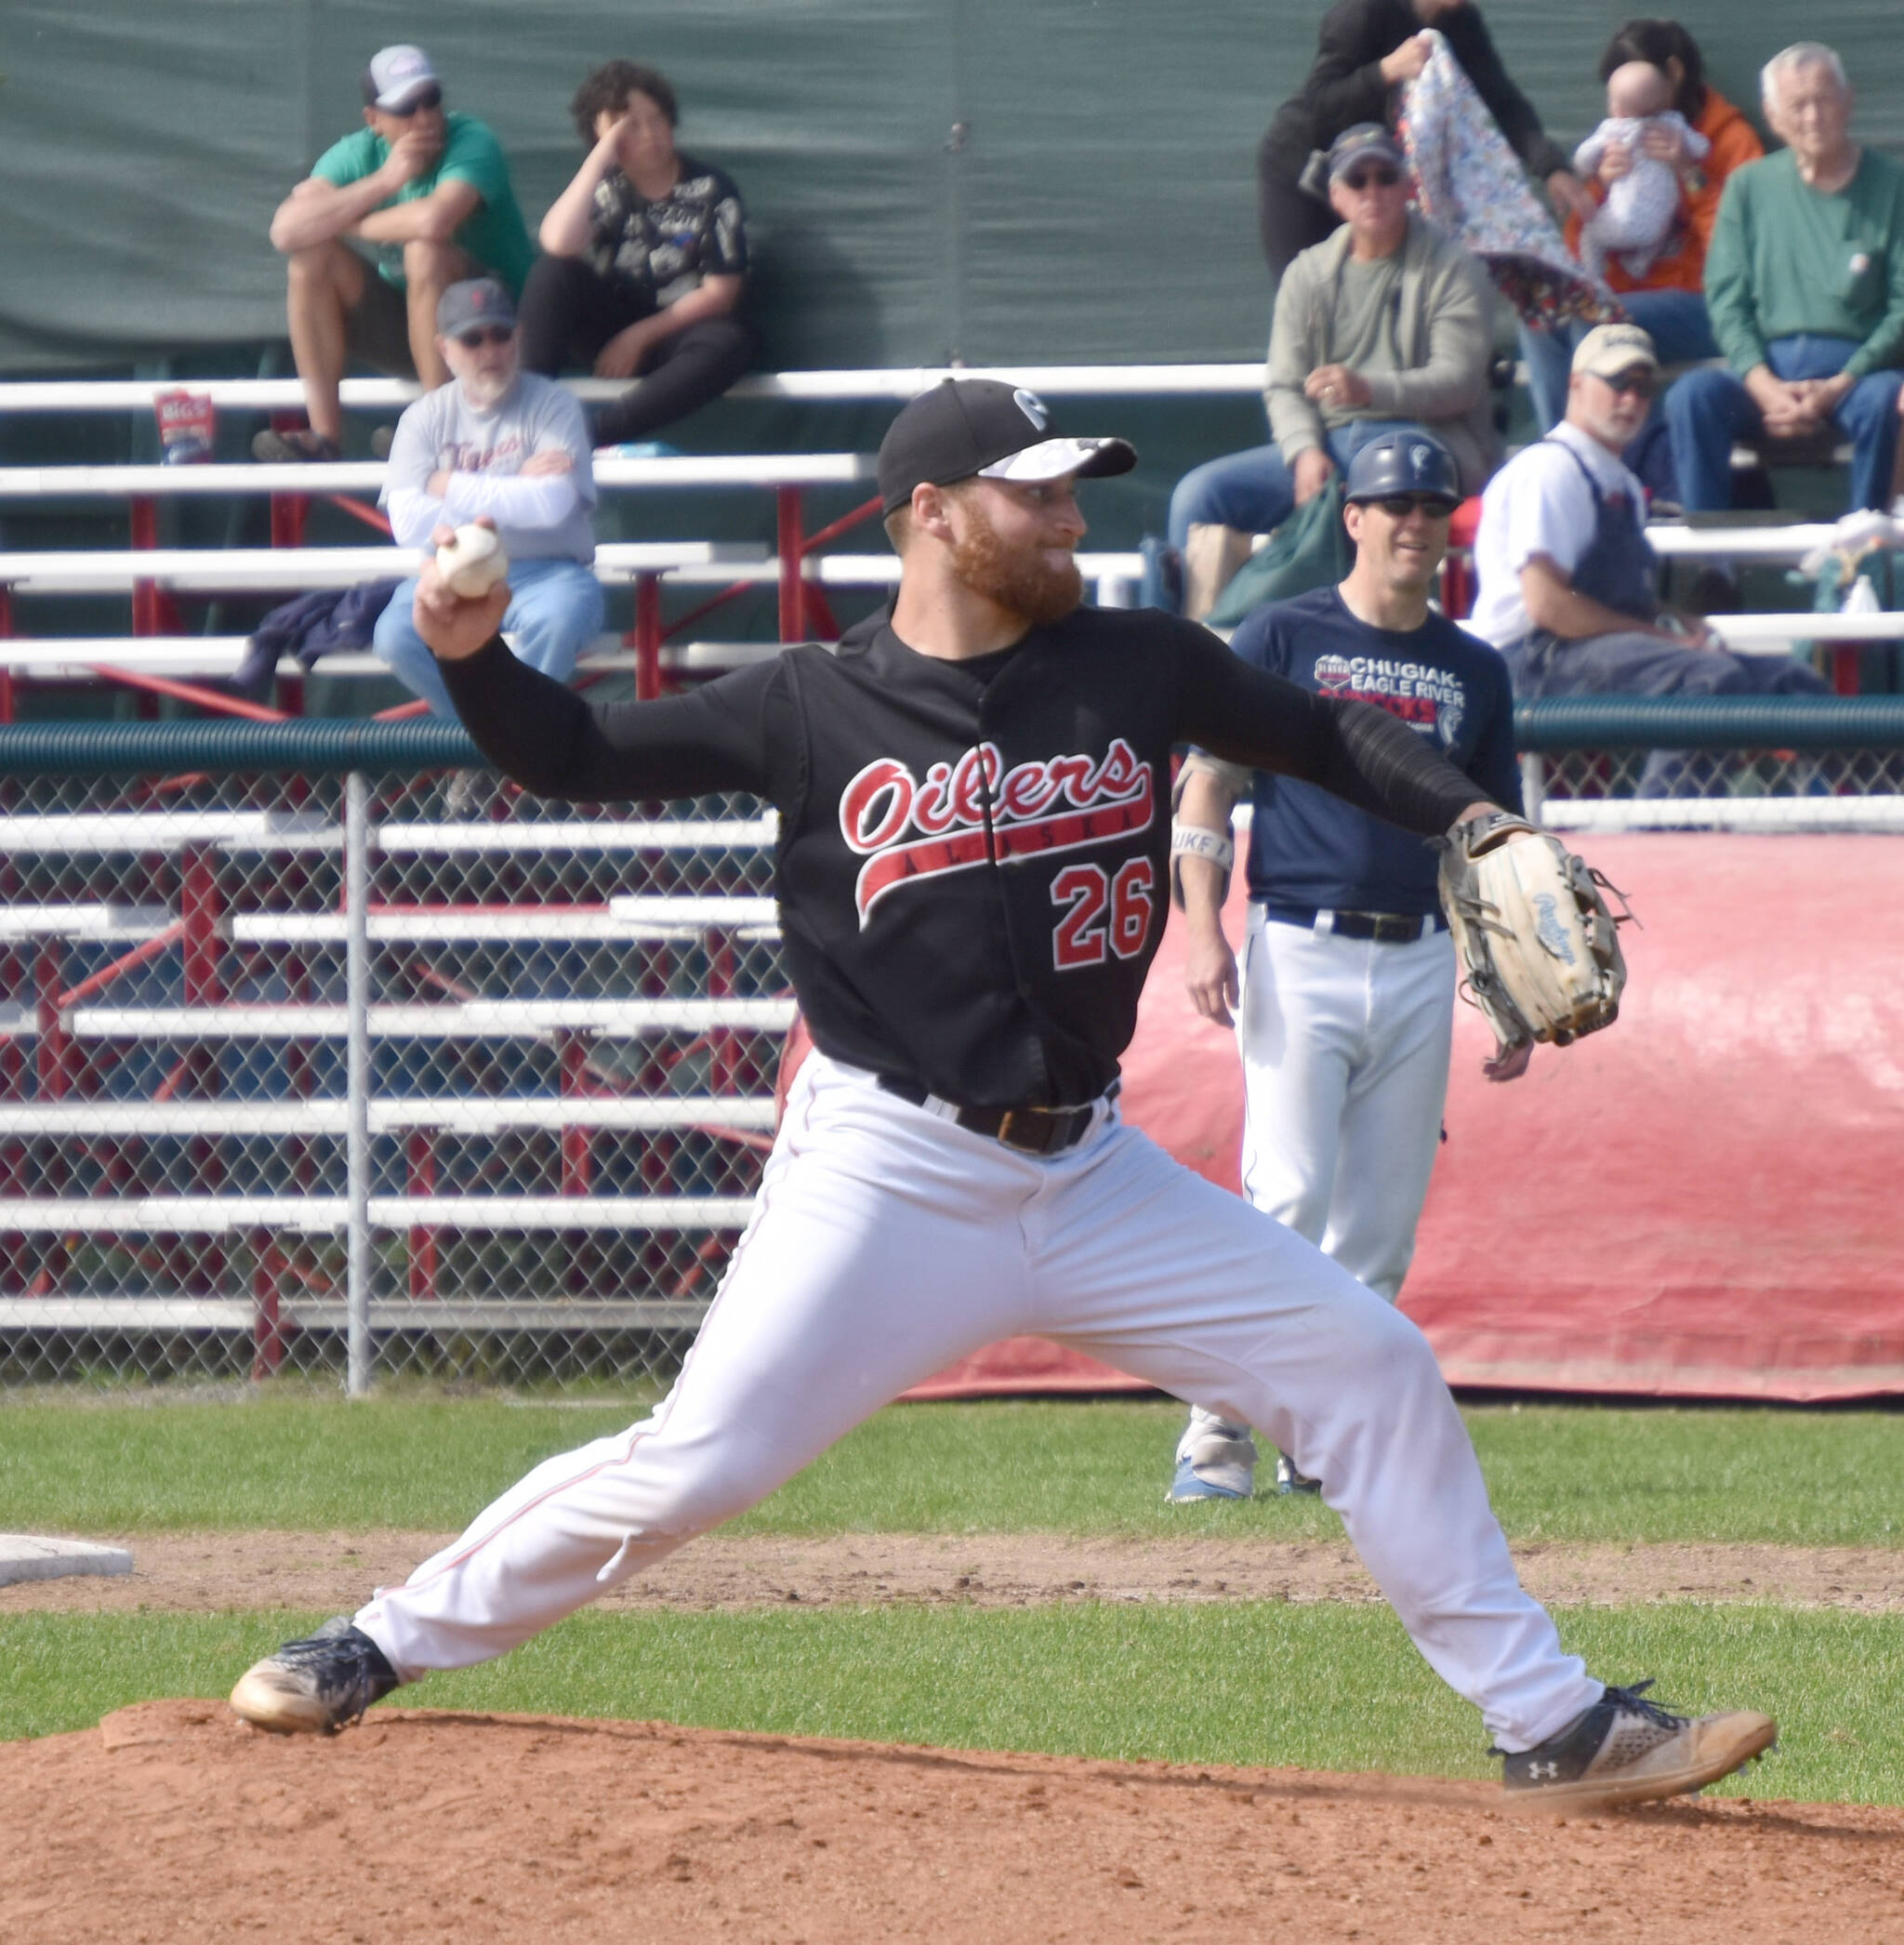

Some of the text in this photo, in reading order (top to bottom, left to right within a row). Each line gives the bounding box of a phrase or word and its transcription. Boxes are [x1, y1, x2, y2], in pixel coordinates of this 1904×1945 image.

[1350, 656, 1463, 689] CHUGIAK-
[1351, 673, 1466, 708] EAGLE RIVER
[839, 738, 1151, 855] Oilers
[904, 813, 1133, 878] ALASKA
[1050, 855, 1154, 972] 26
